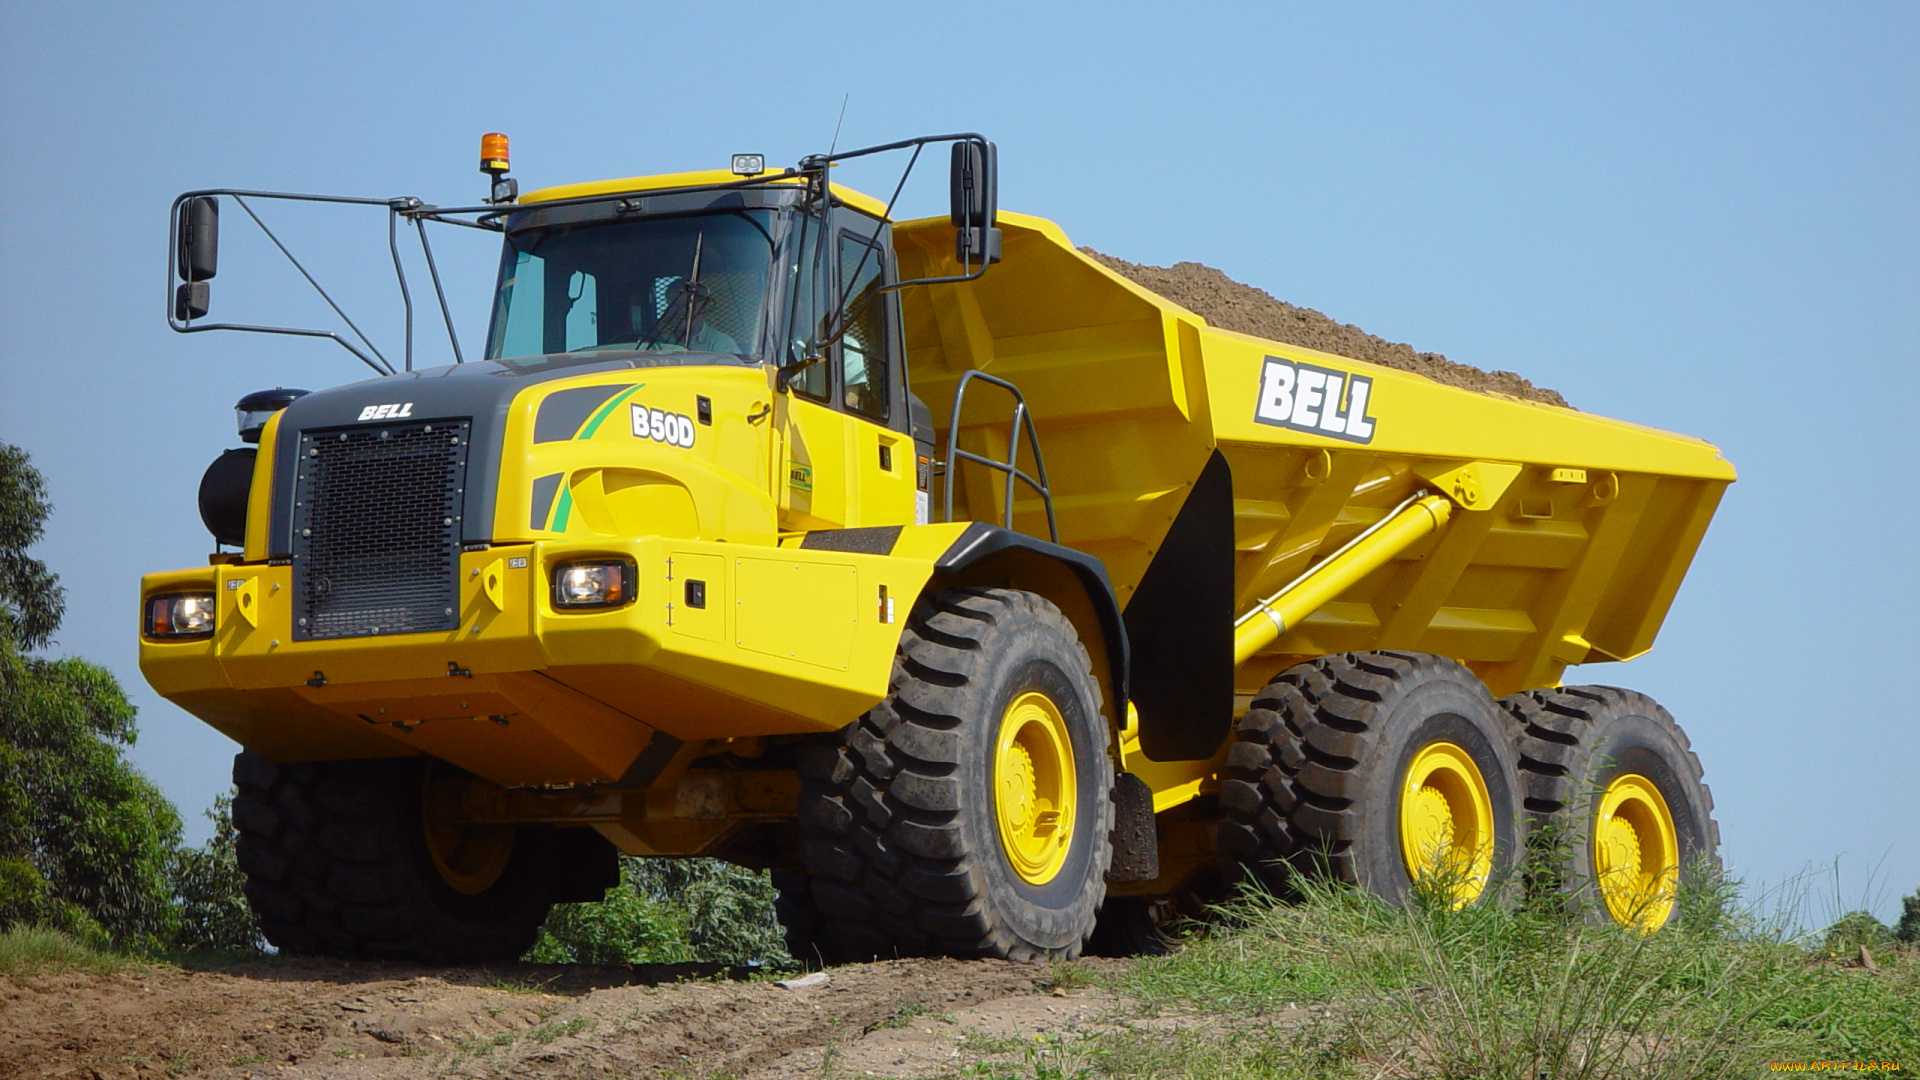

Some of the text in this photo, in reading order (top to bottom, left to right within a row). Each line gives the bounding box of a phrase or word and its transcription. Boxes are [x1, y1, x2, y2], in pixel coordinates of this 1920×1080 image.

[358, 403, 413, 421] BELL
[1256, 357, 1375, 442] BELL
[631, 403, 695, 448] B50D
[790, 470, 806, 482] BELL
